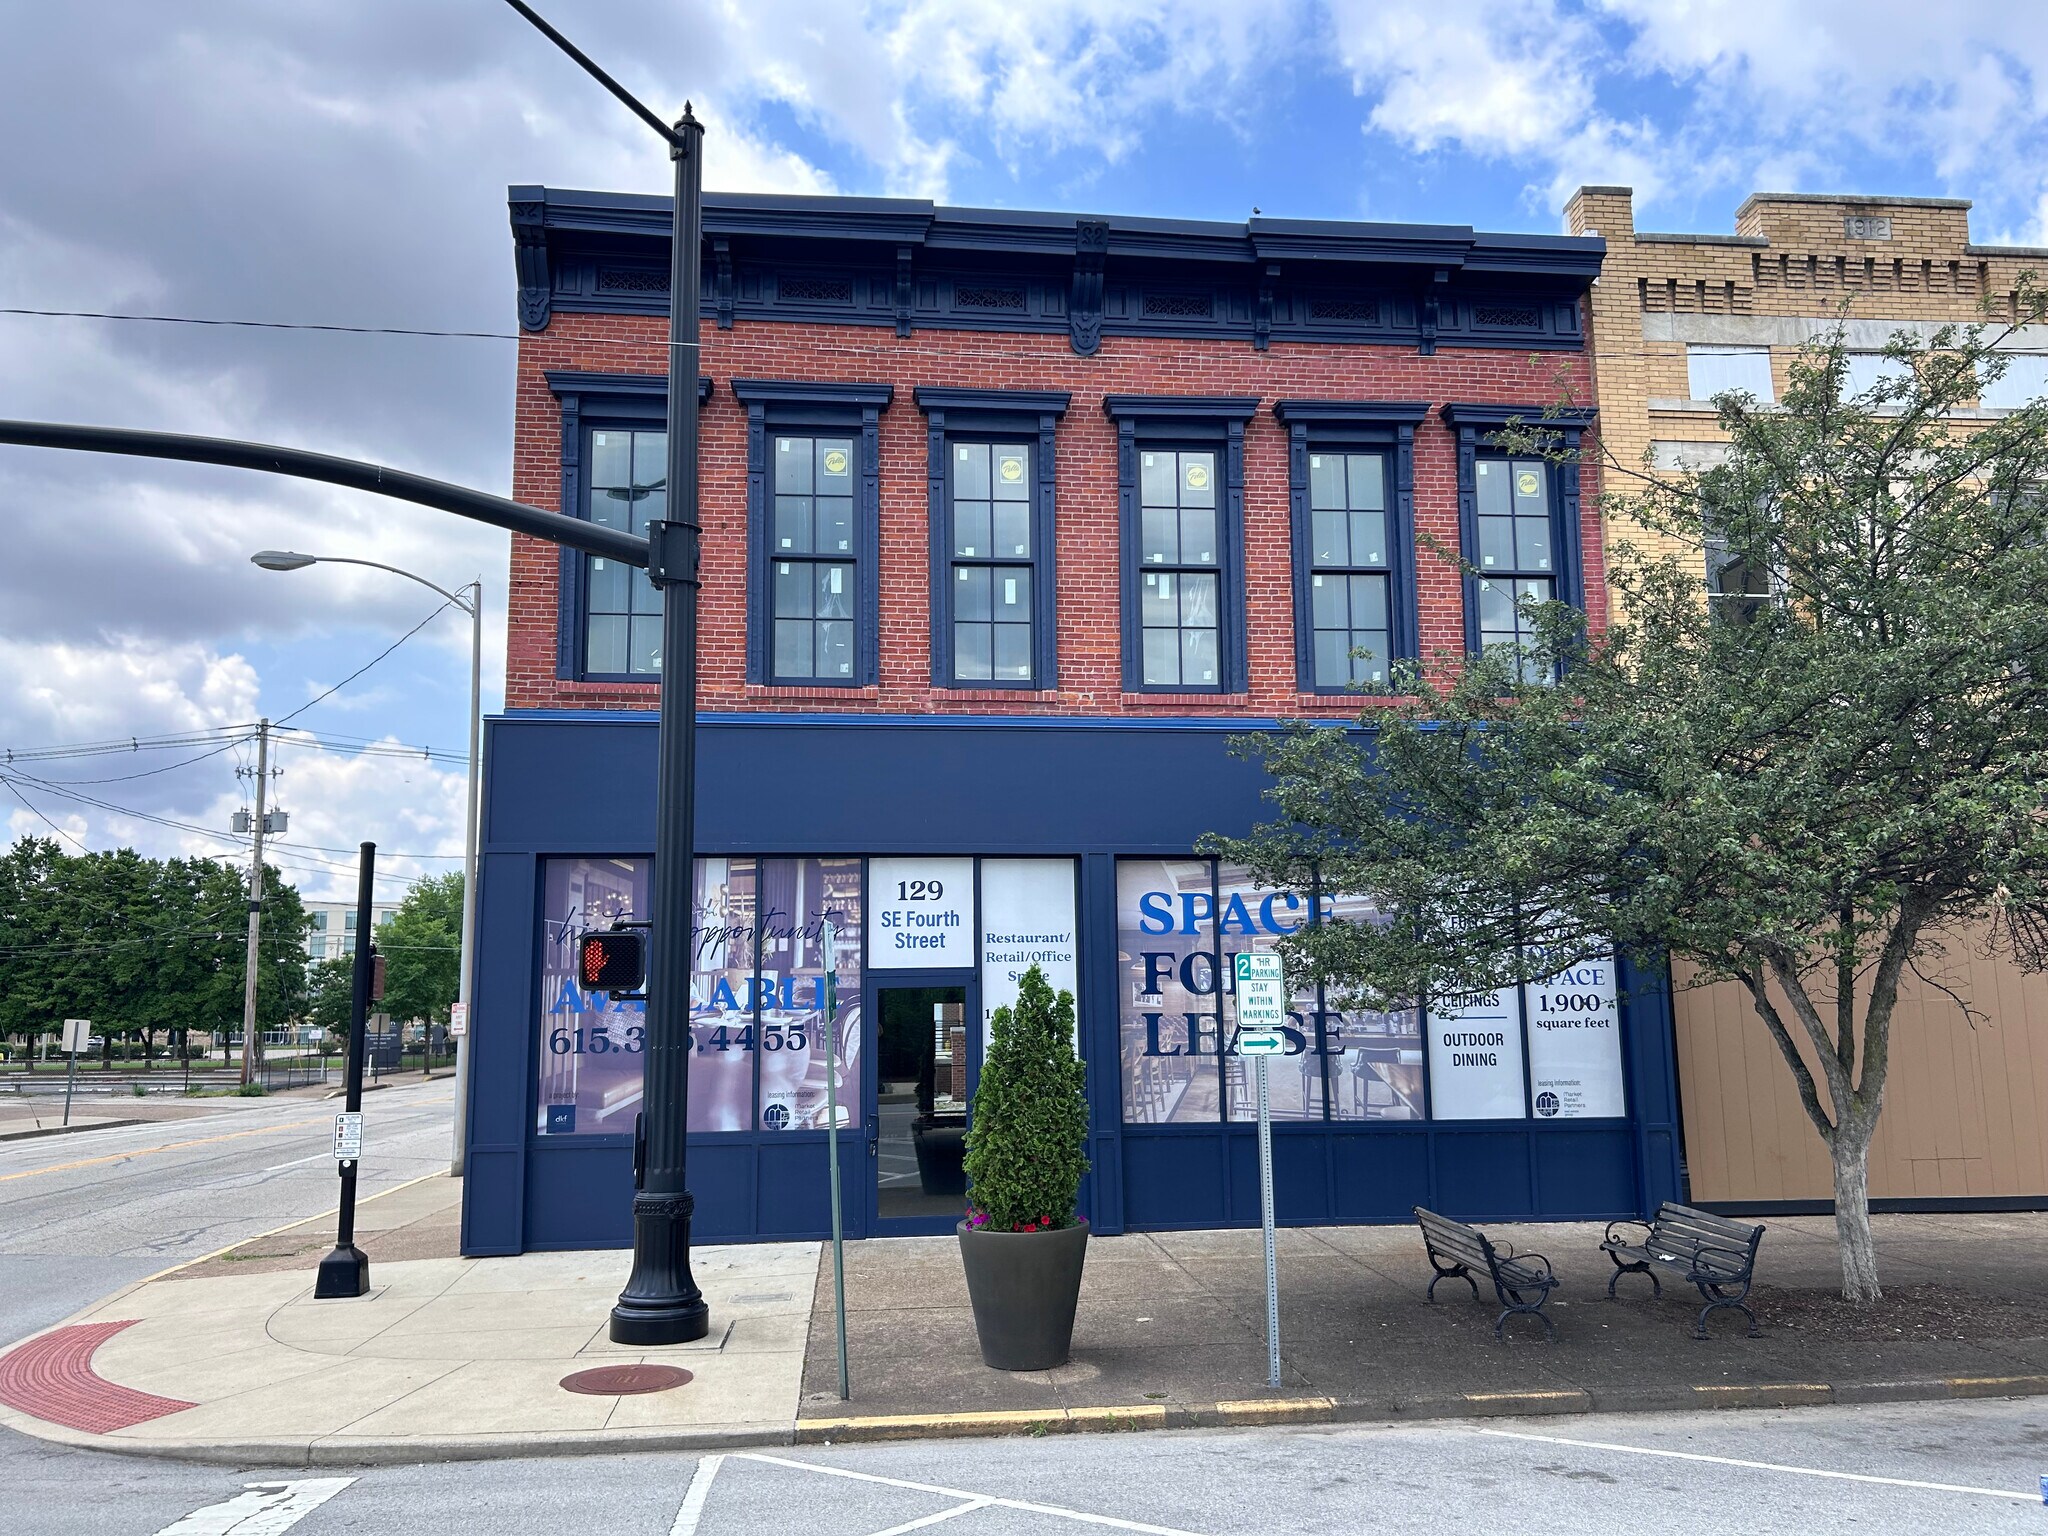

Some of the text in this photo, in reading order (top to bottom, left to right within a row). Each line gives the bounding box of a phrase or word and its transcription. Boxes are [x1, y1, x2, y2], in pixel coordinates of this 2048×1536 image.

[1847, 218, 1888, 236] 1912
[898, 880, 943, 901] 129
[881, 910, 960, 927] SE Fourth
[895, 932, 946, 948] Street
[985, 932, 1071, 944] Restaurant/
[985, 950, 1072, 963] Retail/Office
[1238, 957, 1270, 977] 2 HR
[1251, 968, 1279, 978] PARKING
[1008, 970, 1049, 984] Spe
[1251, 982, 1268, 992] STAY
[1248, 996, 1273, 1005] WITHIN
[1442, 993, 1499, 1009] CEILINGS
[1540, 994, 1600, 1013] 1,900
[1243, 1009, 1279, 1019] MARKINGS
[1536, 1017, 1610, 1031] square feet
[549, 1026, 807, 1054] 615.3.4455
[1443, 1032, 1504, 1047] OUTDOOR
[1453, 1053, 1497, 1067] DINING
